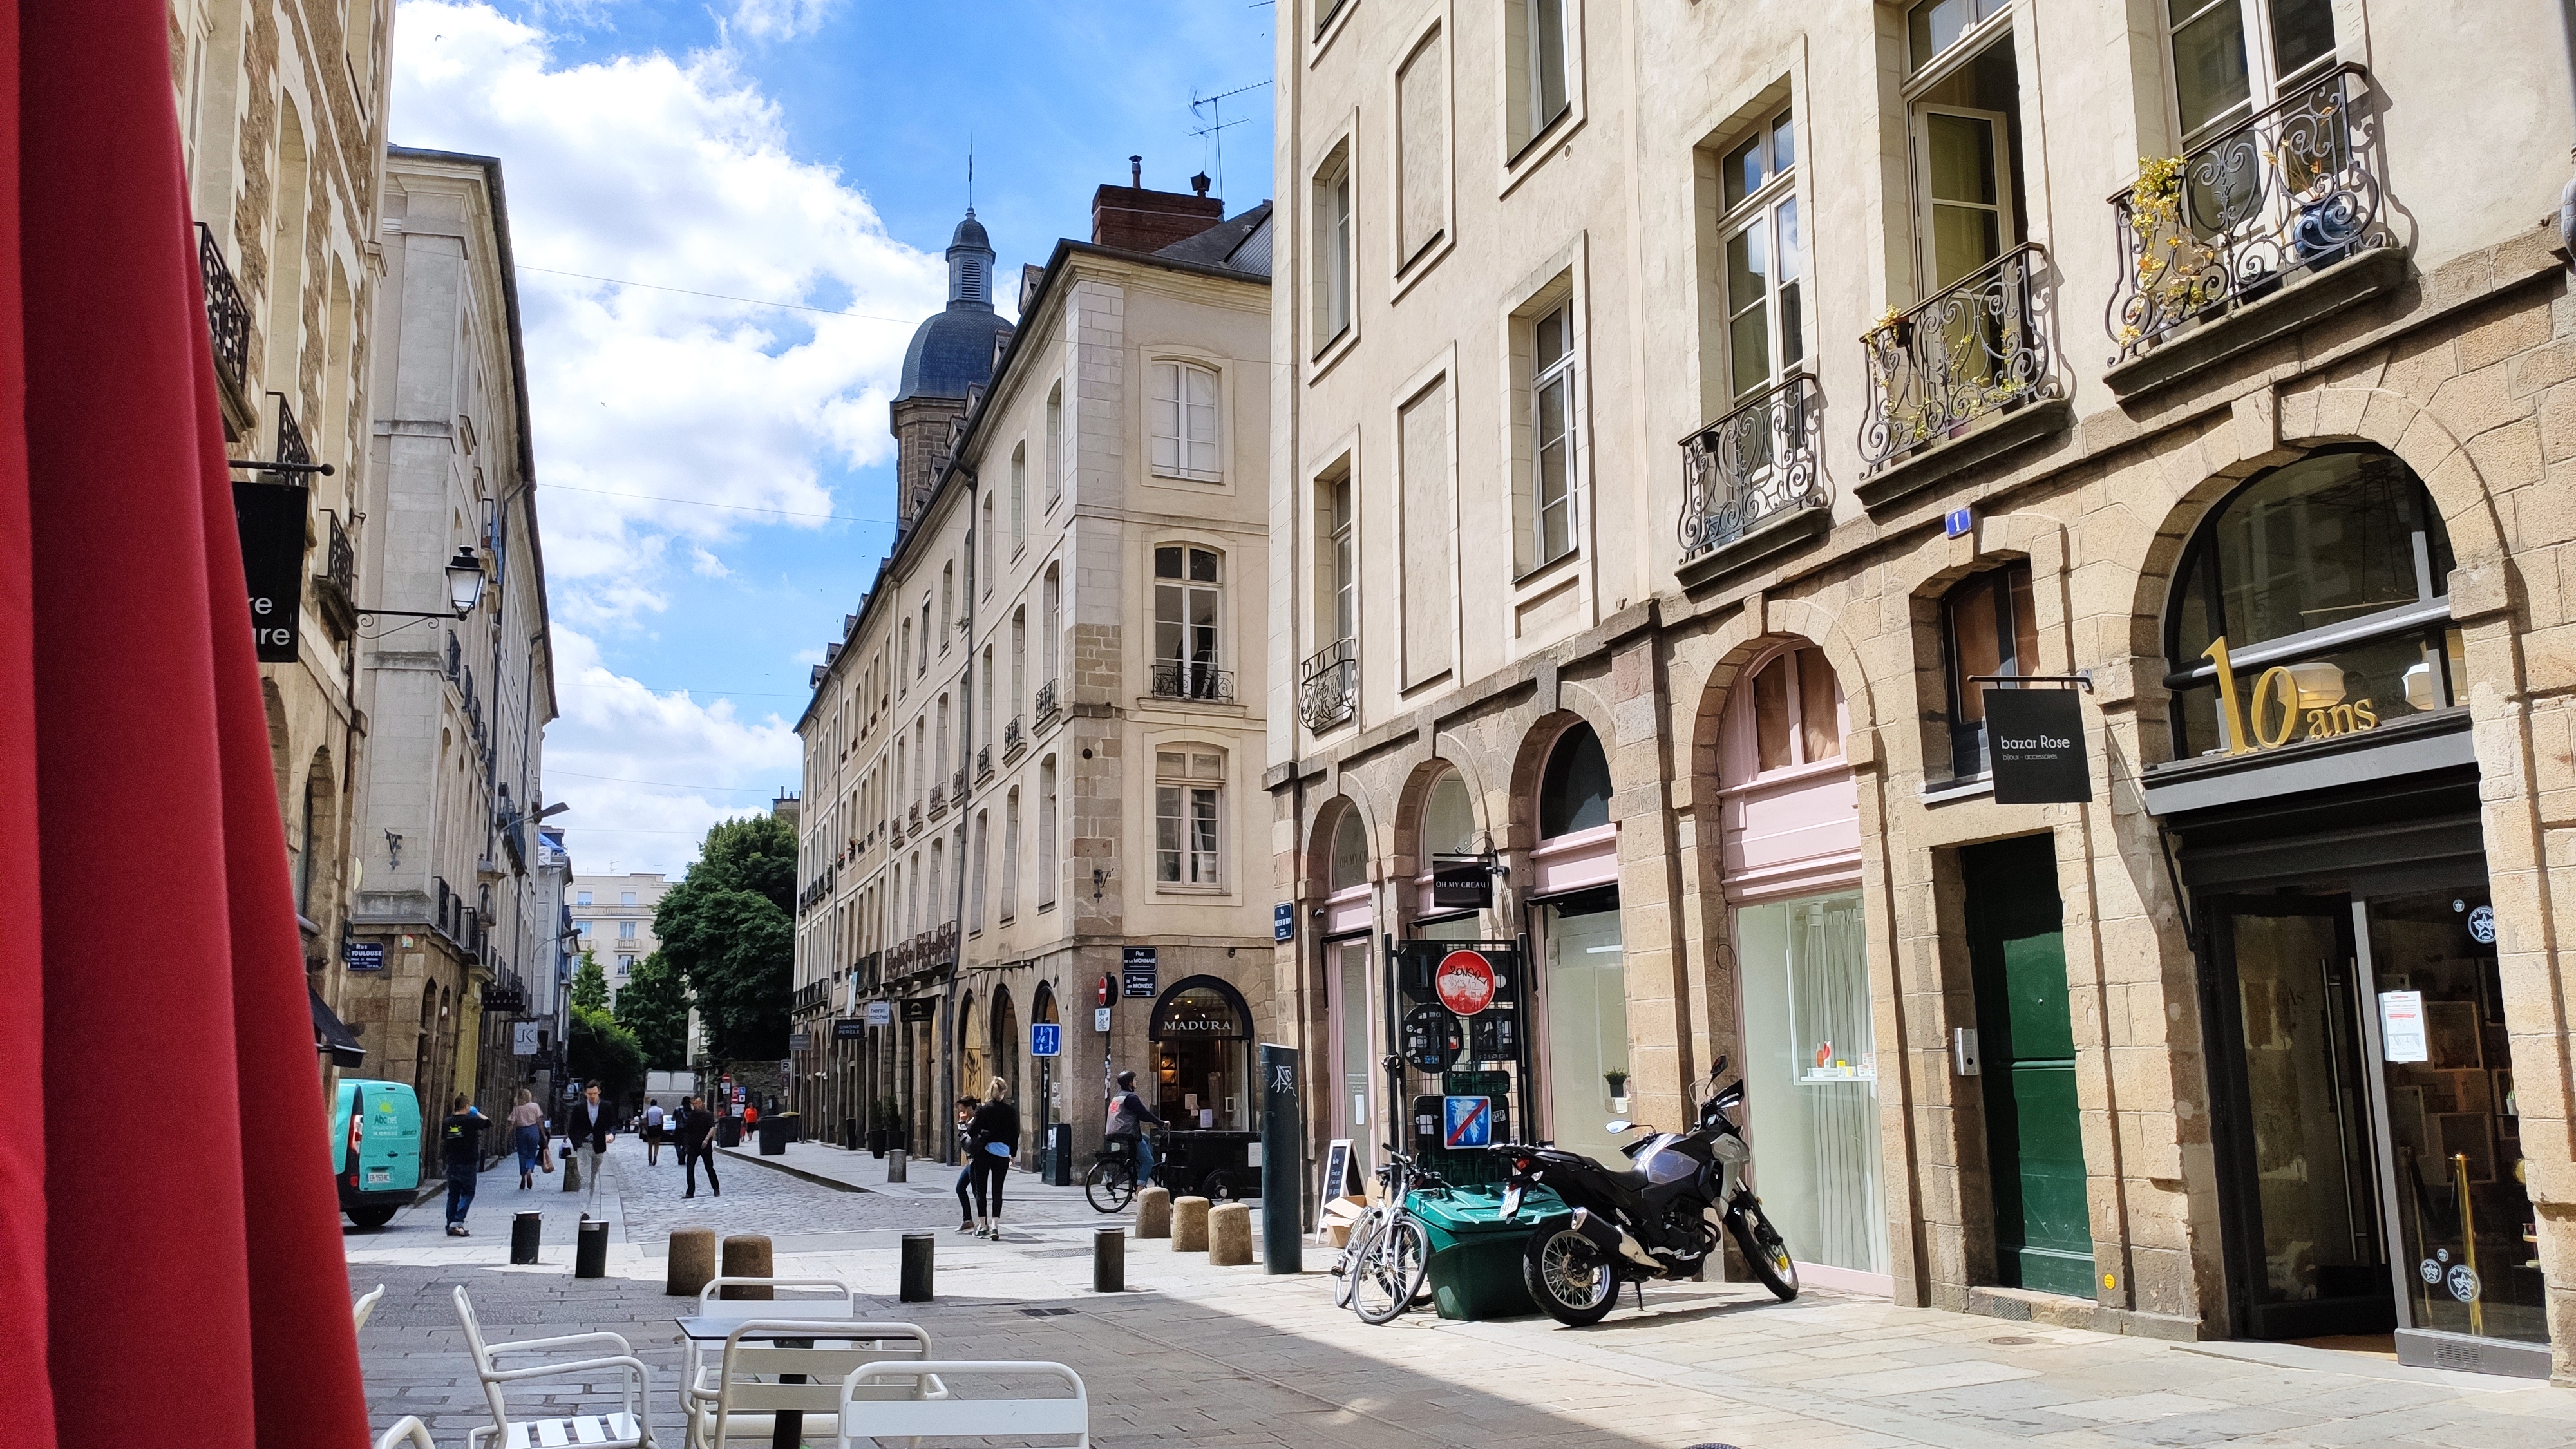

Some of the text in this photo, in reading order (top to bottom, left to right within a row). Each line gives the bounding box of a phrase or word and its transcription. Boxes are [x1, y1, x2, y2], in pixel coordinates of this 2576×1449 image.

[1953, 513, 1962, 532] 1
[2200, 636, 2378, 758] 10 ans
[2000, 735, 2070, 749] bazar Rose
[1163, 1021, 1232, 1030] MADURA
[782, 1063, 790, 1071] P
